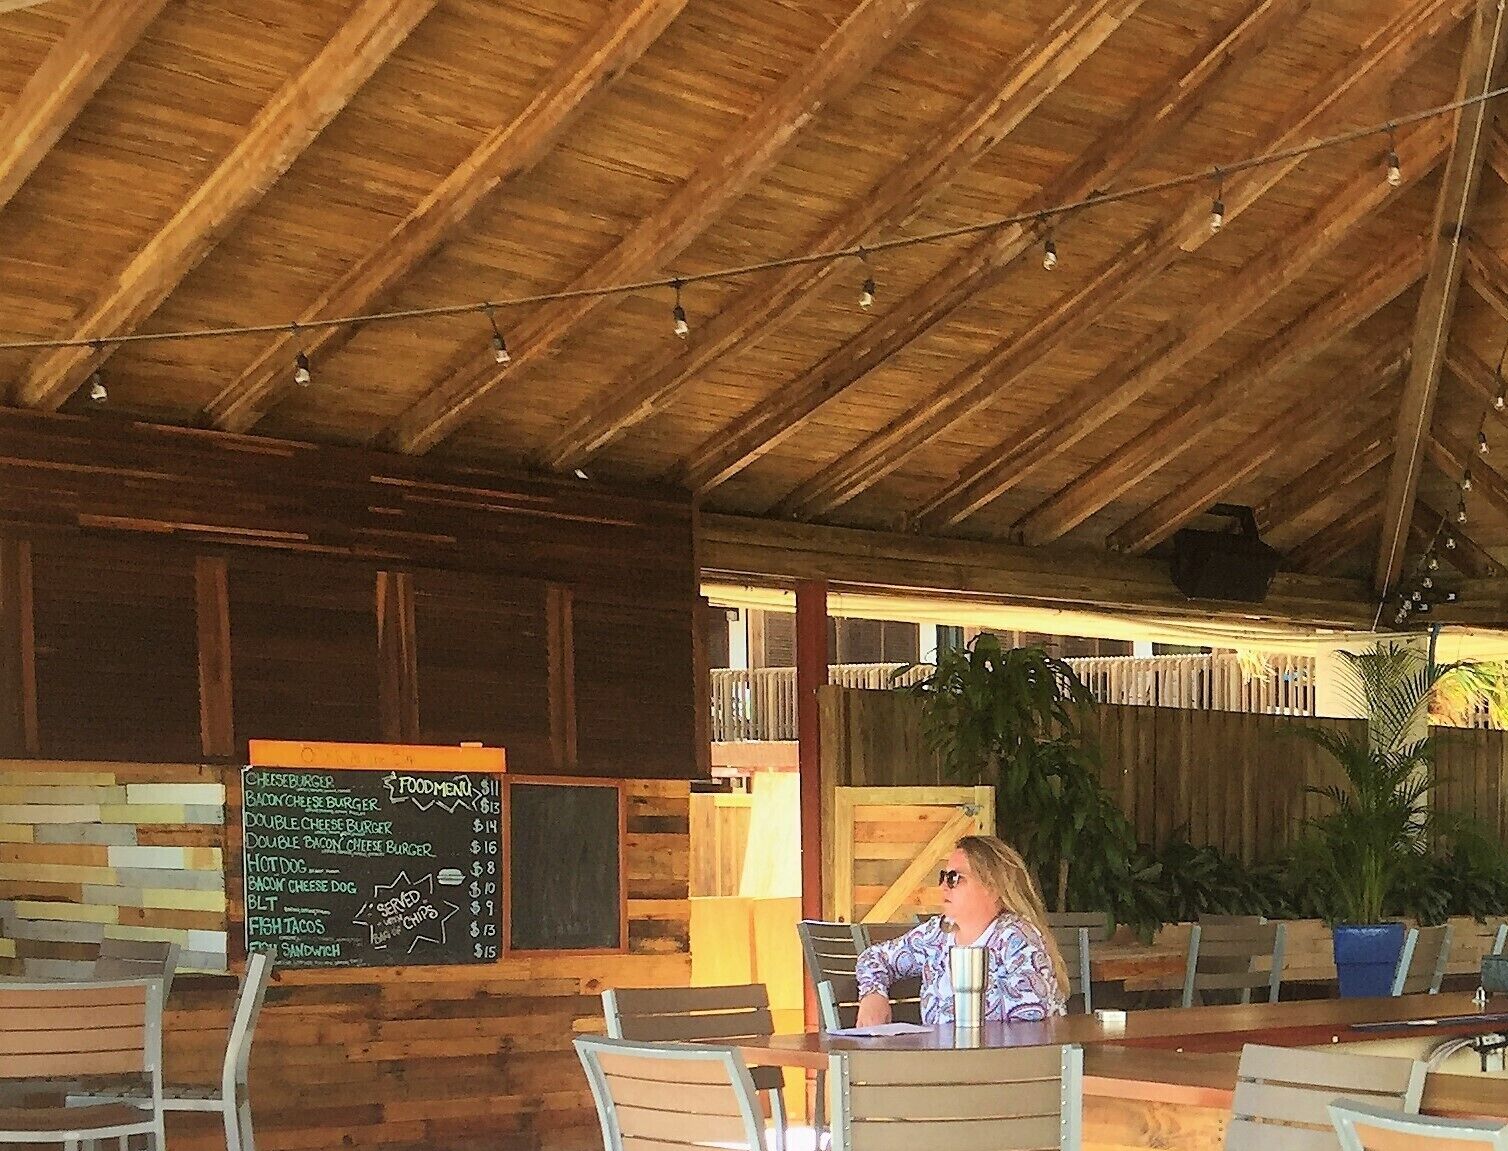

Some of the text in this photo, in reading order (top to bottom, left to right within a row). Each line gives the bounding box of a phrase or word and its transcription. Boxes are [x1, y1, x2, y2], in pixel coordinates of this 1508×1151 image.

[285, 793, 324, 809] CHEESE
[326, 796, 382, 812] BURGER
[244, 811, 301, 830] DOUBLE
[301, 816, 344, 832] CHEESE
[345, 818, 393, 835] BURGER
[245, 832, 301, 849] DOUBLE
[346, 839, 384, 852] CHEESE
[385, 840, 437, 858] BURGER
[248, 875, 358, 895] BACON CHEESE DOG
[248, 894, 278, 912] BLT
[377, 890, 421, 917] SERVED
[248, 916, 326, 936] FISH TACOS
[402, 904, 439, 930] CHIPS
[281, 942, 341, 958] SANDWICH
